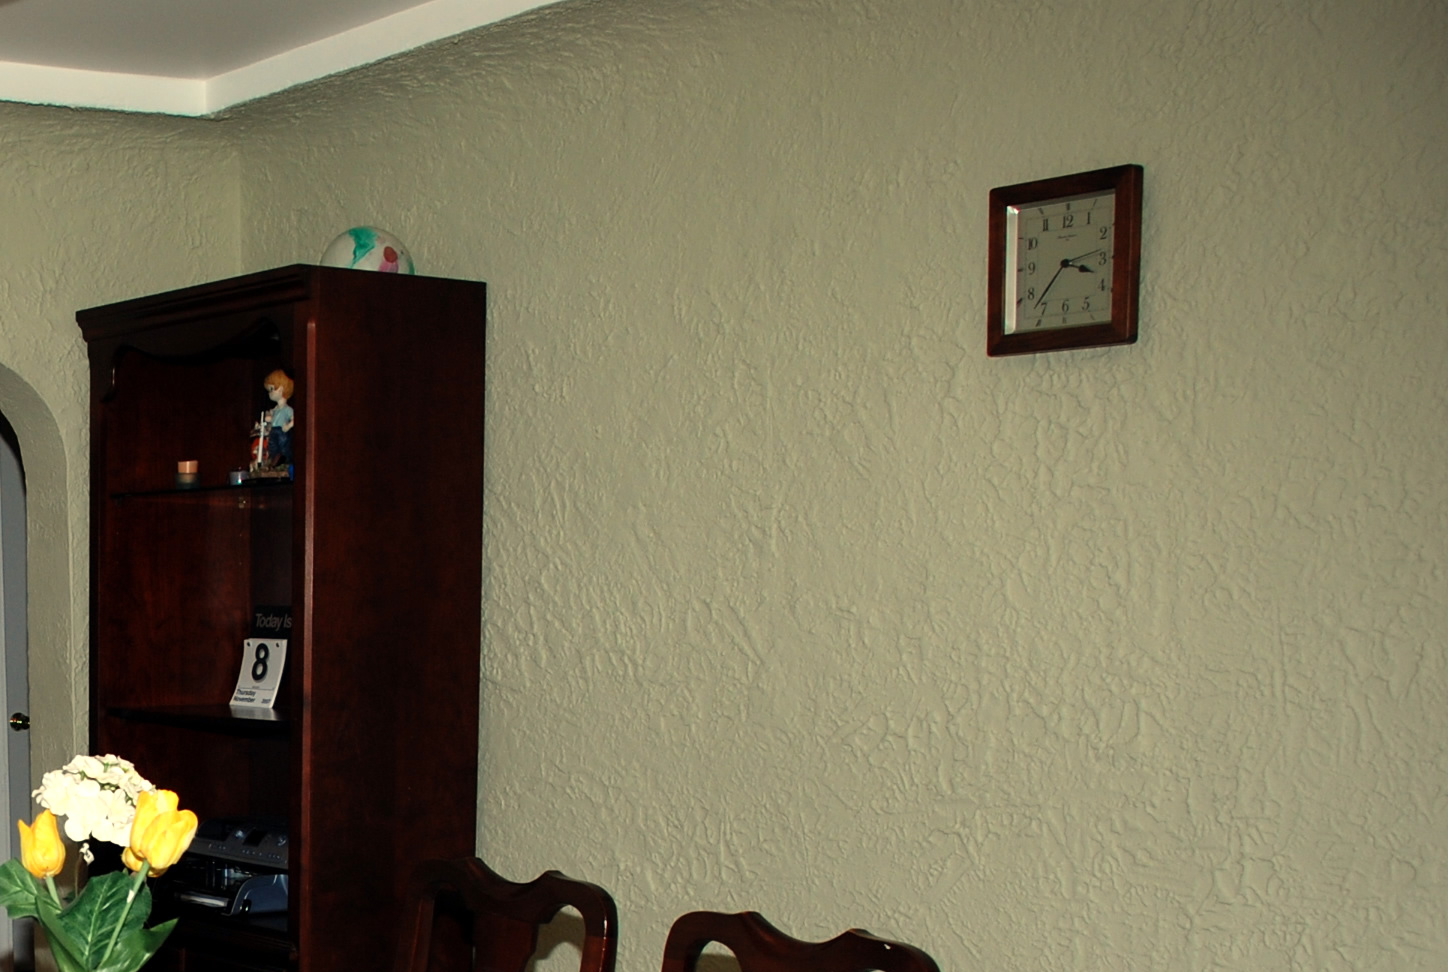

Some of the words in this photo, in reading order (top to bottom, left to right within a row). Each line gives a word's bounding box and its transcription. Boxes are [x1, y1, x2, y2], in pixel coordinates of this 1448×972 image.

[1042, 218, 1050, 233] 11
[1062, 214, 1074, 229] 12
[1086, 211, 1092, 226] 1
[1099, 226, 1108, 241] 2
[1027, 237, 1039, 251] 10
[1098, 252, 1107, 266] 3
[1027, 262, 1036, 276] 9
[1097, 279, 1106, 292] 4
[1027, 289, 1035, 301] 8
[1039, 303, 1048, 316] 7
[1061, 299, 1070, 313] 6
[1081, 298, 1091, 312] 5
[255, 612, 283, 632] Today
[283, 613, 293, 629] Is
[251, 642, 270, 682] 8
[236, 688, 256, 697] Thursday
